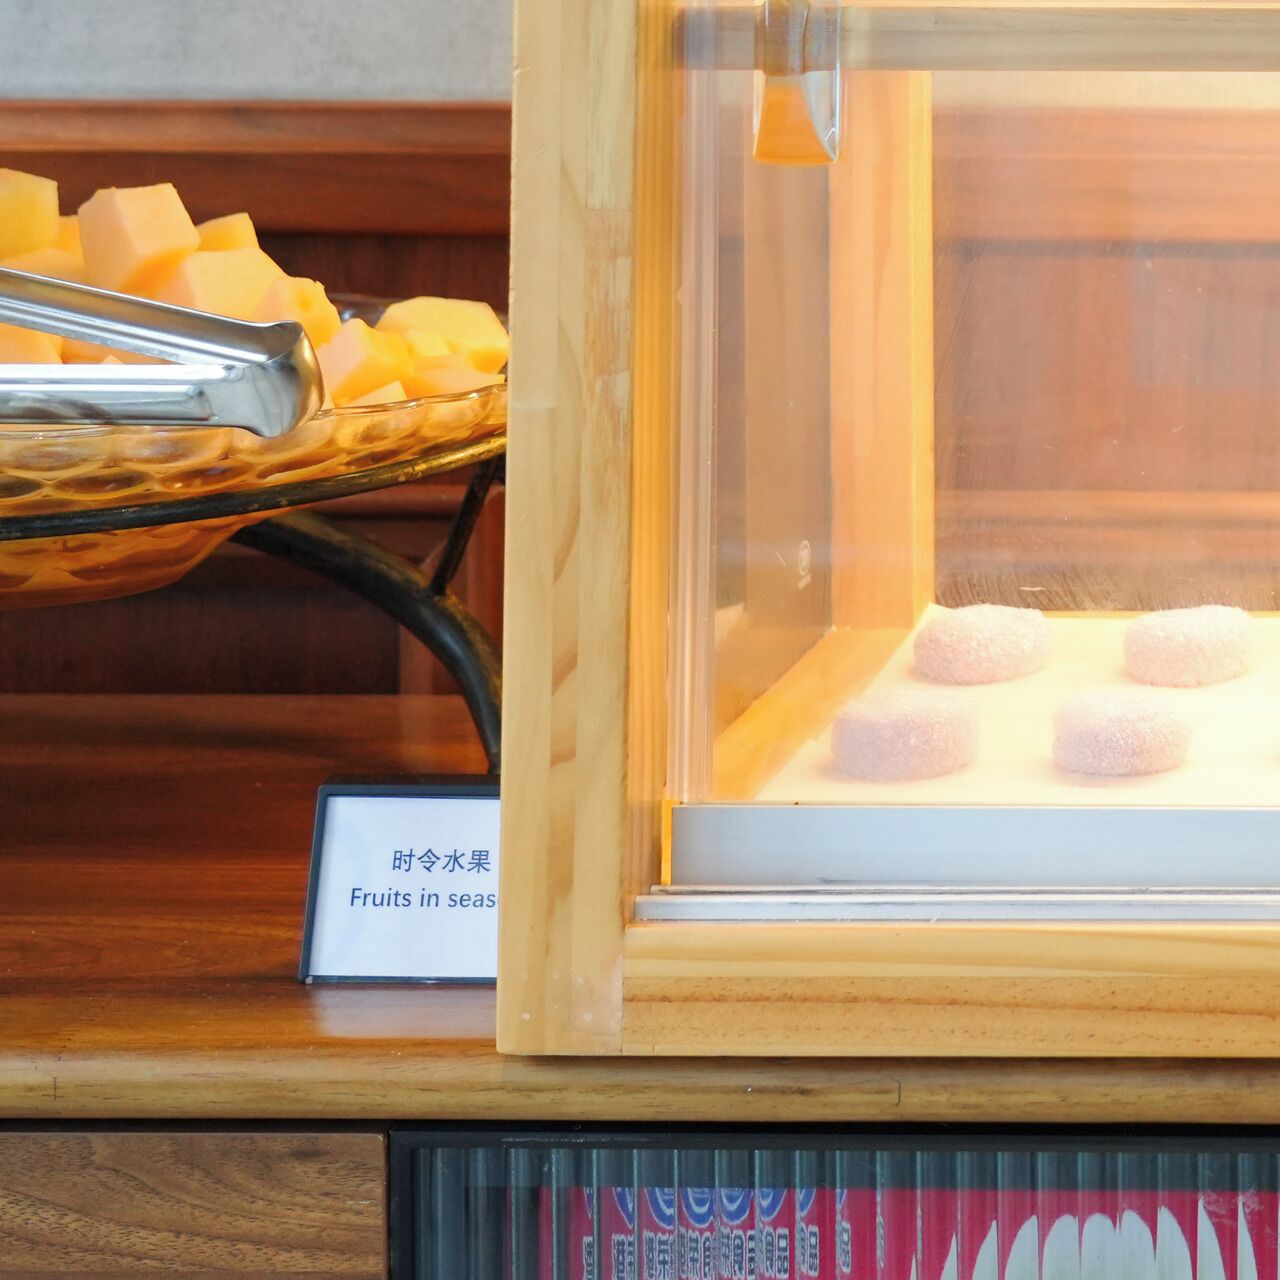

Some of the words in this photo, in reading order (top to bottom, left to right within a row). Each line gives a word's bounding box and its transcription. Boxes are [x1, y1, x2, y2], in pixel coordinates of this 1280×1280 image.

[393, 849, 490, 873] 时令水果
[351, 888, 411, 907] Fruits
[420, 888, 439, 907] in
[447, 891, 498, 909] seas
